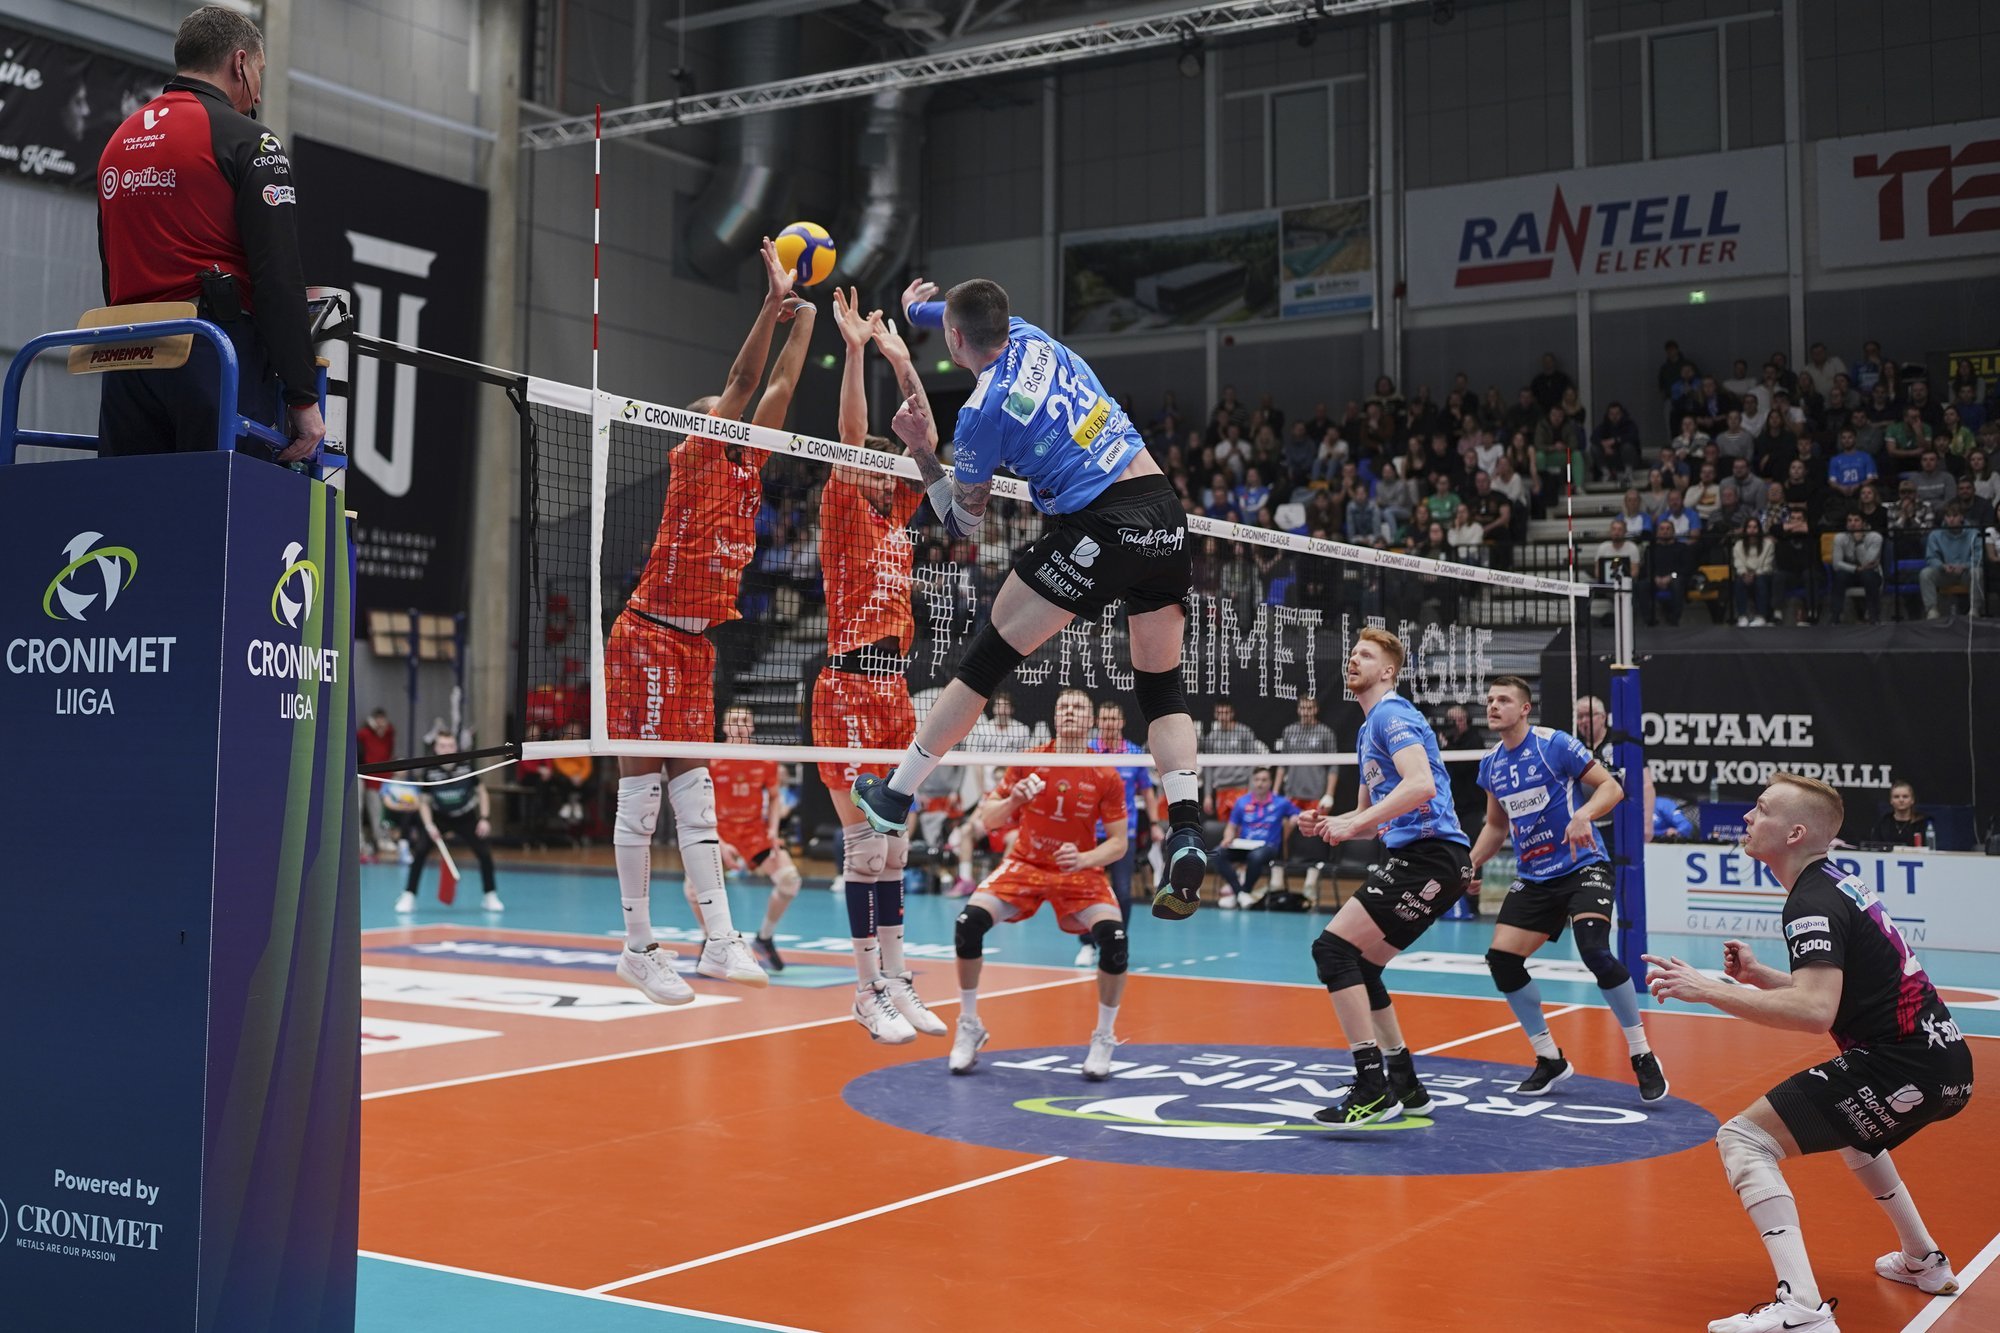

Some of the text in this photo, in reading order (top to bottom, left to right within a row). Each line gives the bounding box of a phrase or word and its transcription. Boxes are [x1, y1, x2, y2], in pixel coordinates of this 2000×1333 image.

[123, 134, 165, 144] VOLEJBOLS
[125, 142, 156, 151] LATVIJA
[253, 154, 290, 168] CRONIM
[121, 166, 176, 191] Optibet
[1458, 183, 1741, 275] RANTELL
[1595, 239, 1738, 274] ELEKTER
[90, 347, 154, 363] PESMENPOL
[1046, 366, 1098, 438] 25
[644, 407, 751, 441] CRONIMET LEAGUE
[807, 440, 896, 471] CRONIMET LEAGUE
[991, 479, 1018, 494] EAGUE
[1189, 518, 1212, 532] LEAGUE
[1241, 528, 1290, 546] CRONIMET LEAGUE
[1316, 542, 1359, 558] CRONIMET LEAGUE
[1041, 562, 1083, 598] SEKURIT
[1050, 550, 1095, 590] Bigbank
[6, 637, 177, 674] CRONIMET
[247, 639, 339, 684] CRONIMET
[56, 688, 115, 715] LIIGA
[281, 693, 314, 720] LIIGA
[1641, 712, 1813, 747] OETAME
[1509, 764, 1520, 789] 5
[1647, 759, 1709, 784] RTU
[1054, 796, 1064, 817] 1
[1509, 793, 1547, 812] Bigbank
[1686, 852, 1924, 894] SEKIT
[1687, 914, 1783, 934] GLAZING
[1795, 920, 1827, 931] Bigbank
[1179, 1053, 1527, 1093] LEGUE
[1844, 1097, 1883, 1138] SEKURIT
[54, 1168, 160, 1206] Powered by
[17, 1204, 163, 1251] CRONIMET
[16, 1238, 116, 1262] METALS ARE OUR PASSION
